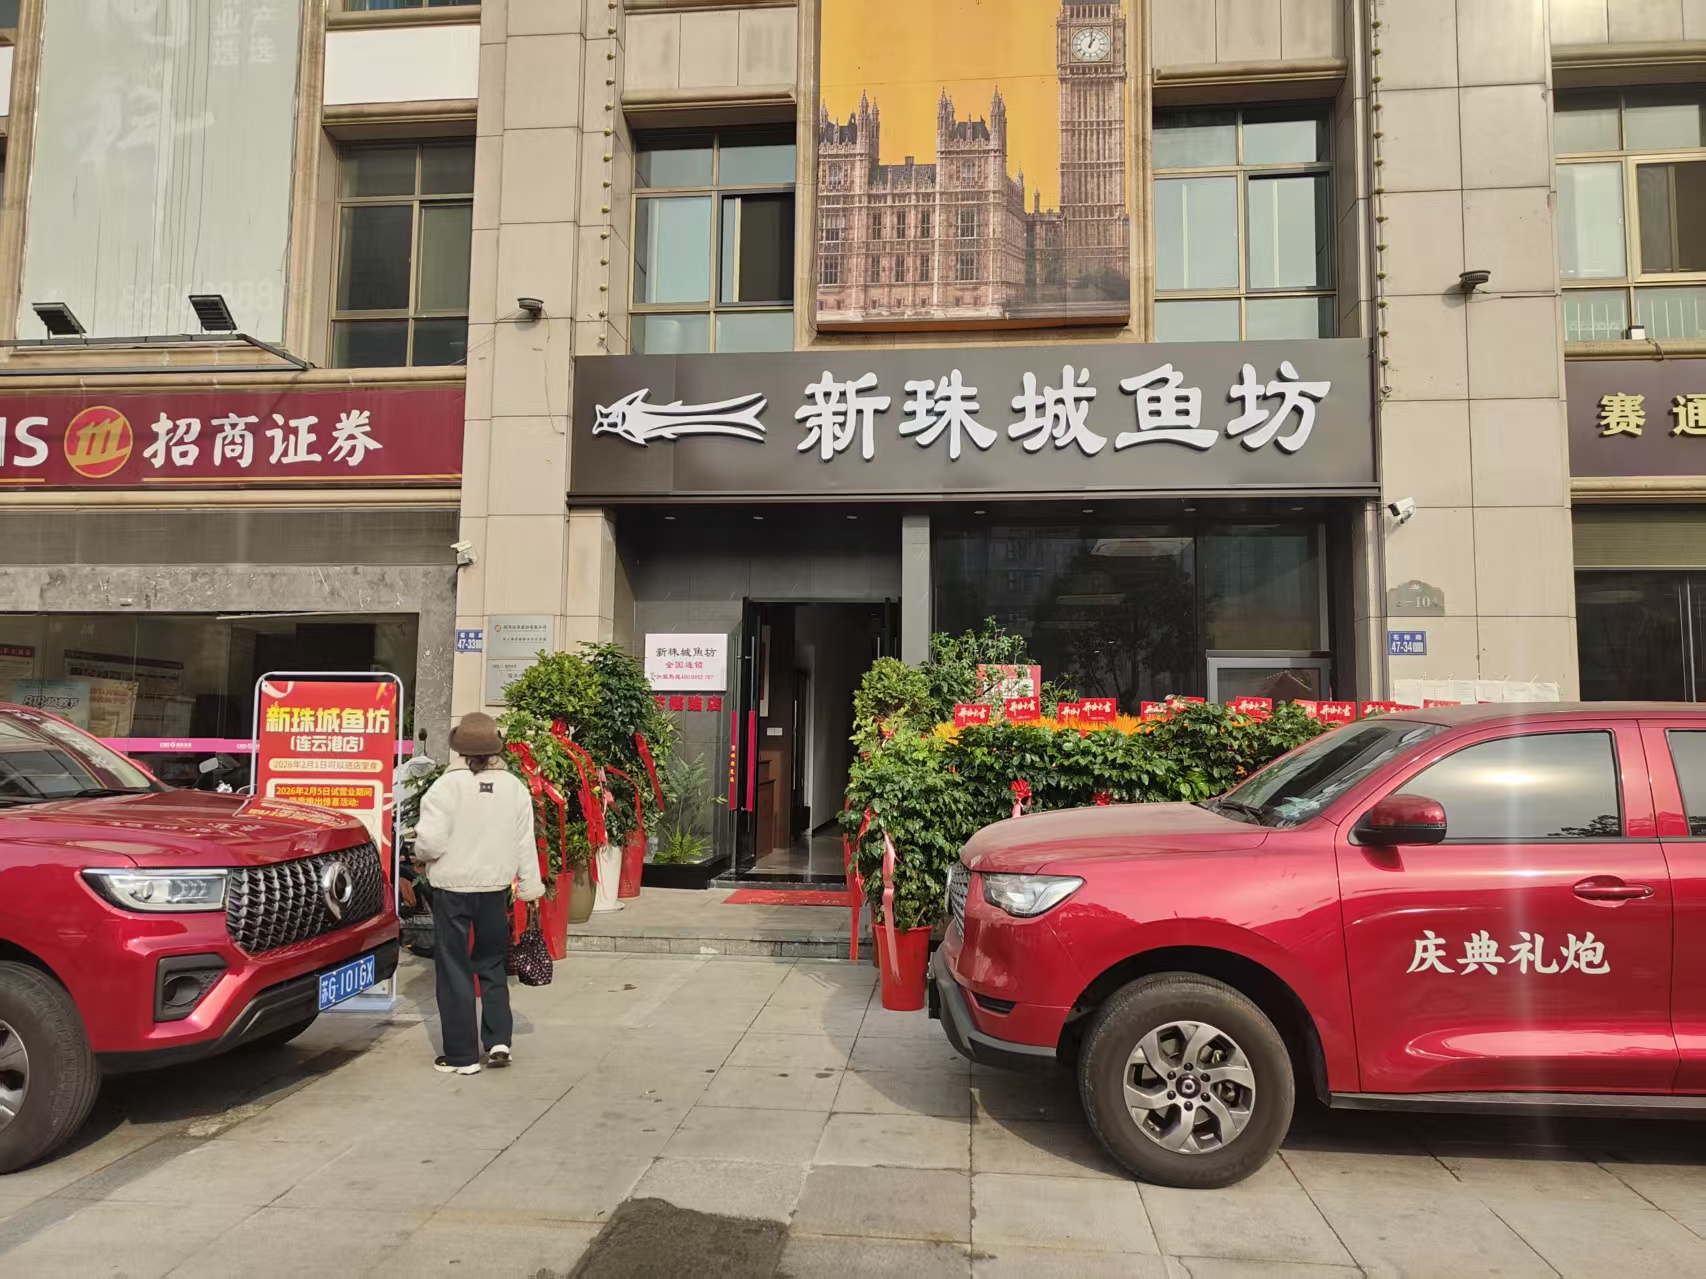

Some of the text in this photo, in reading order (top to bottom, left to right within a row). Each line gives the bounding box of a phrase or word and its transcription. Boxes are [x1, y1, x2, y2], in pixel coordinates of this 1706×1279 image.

[796, 361, 1331, 461] 新珠城鱼坊
[1598, 391, 1706, 436] 赛通
[143, 409, 383, 468] 招商证券
[1391, 641, 1413, 653] 47-34
[265, 704, 390, 734] 新珠城鱼坊
[276, 786, 373, 797] 2026年2月5日试营业期间
[1406, 930, 1611, 975] 庆典礼炮
